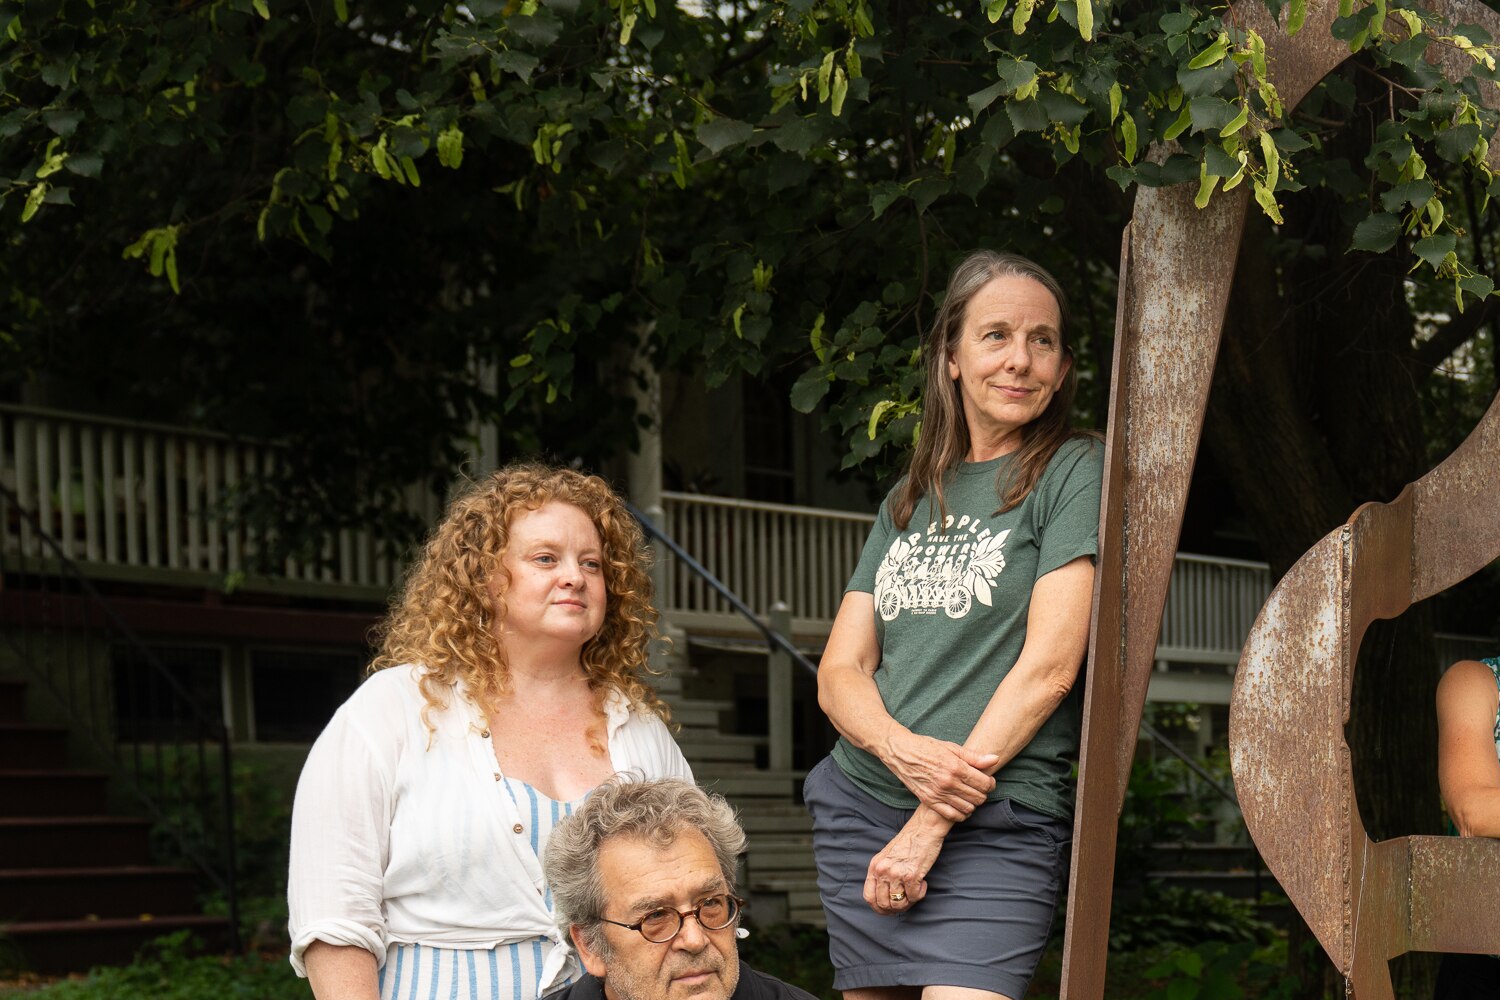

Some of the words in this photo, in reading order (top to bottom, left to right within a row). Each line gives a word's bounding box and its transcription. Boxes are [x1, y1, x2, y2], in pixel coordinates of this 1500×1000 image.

[908, 515, 991, 546] PEOPLE
[953, 533, 969, 542] THE
[913, 543, 971, 557] POWER
